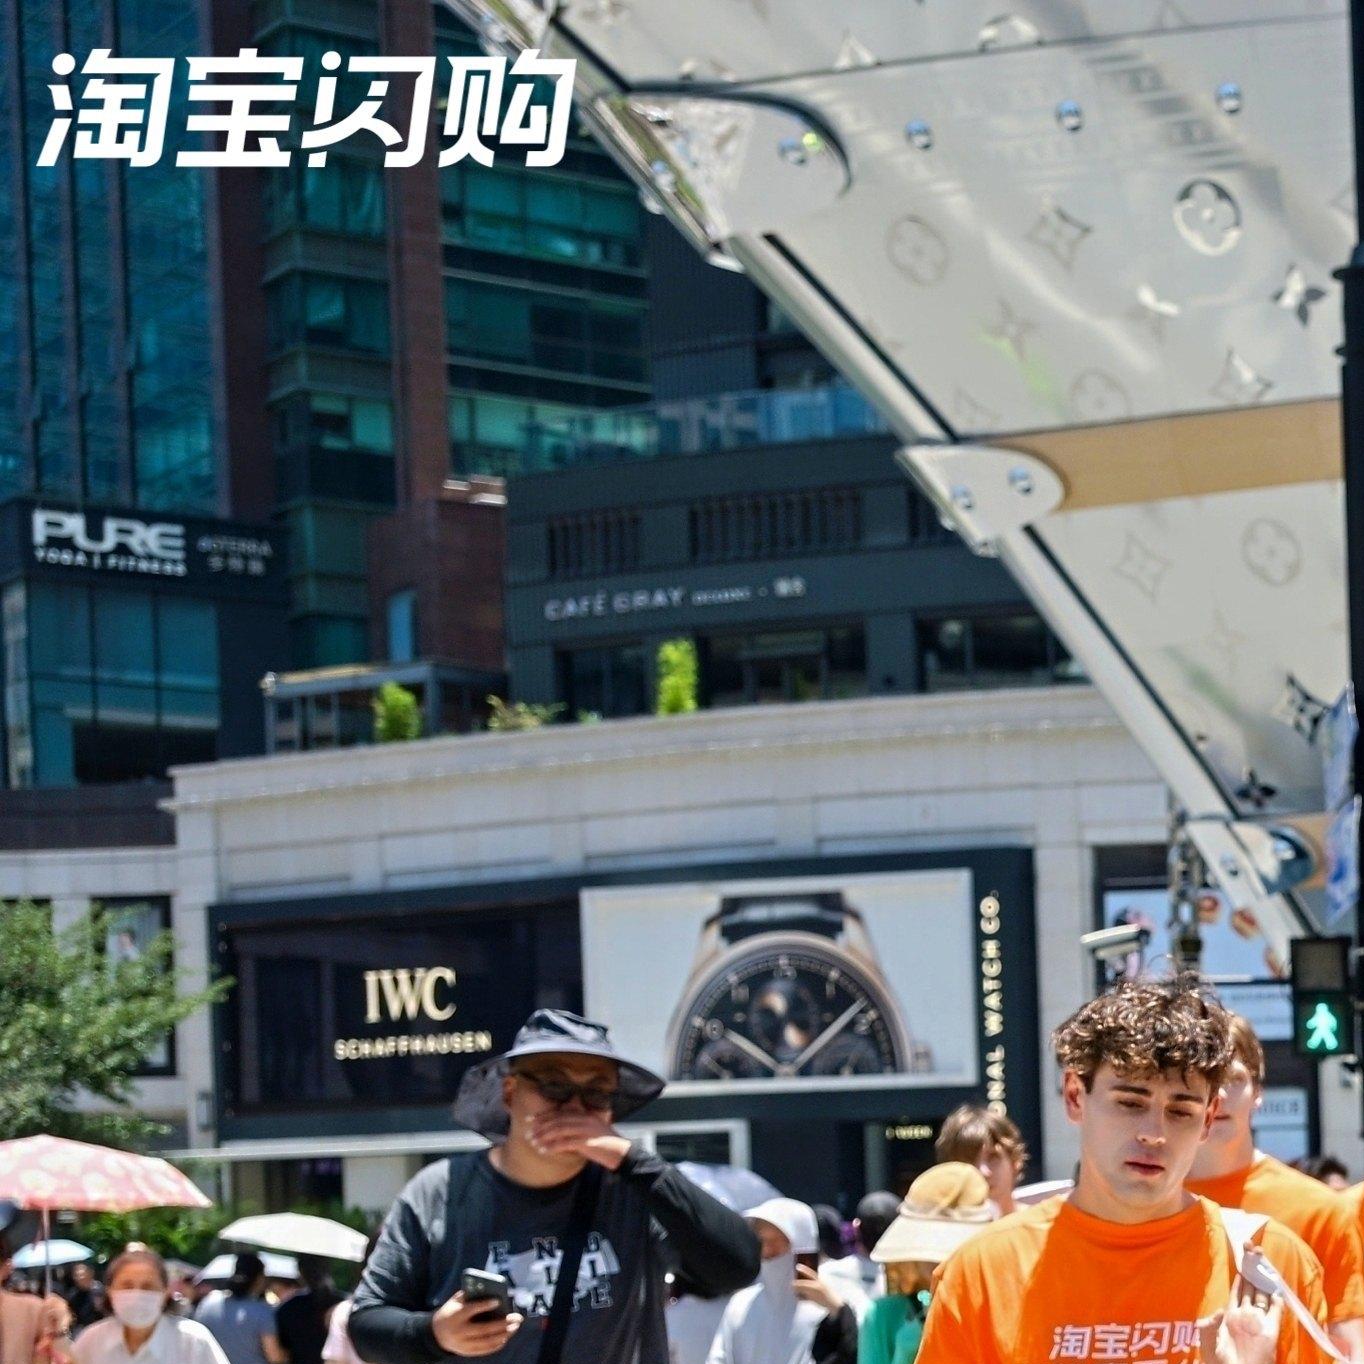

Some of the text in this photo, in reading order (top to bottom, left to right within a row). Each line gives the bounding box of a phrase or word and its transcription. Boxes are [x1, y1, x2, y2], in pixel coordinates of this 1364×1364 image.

[32, 508, 187, 561] PURE
[363, 966, 457, 1024] IWC
[334, 1030, 493, 1061] SCHAFFHAUSEN
